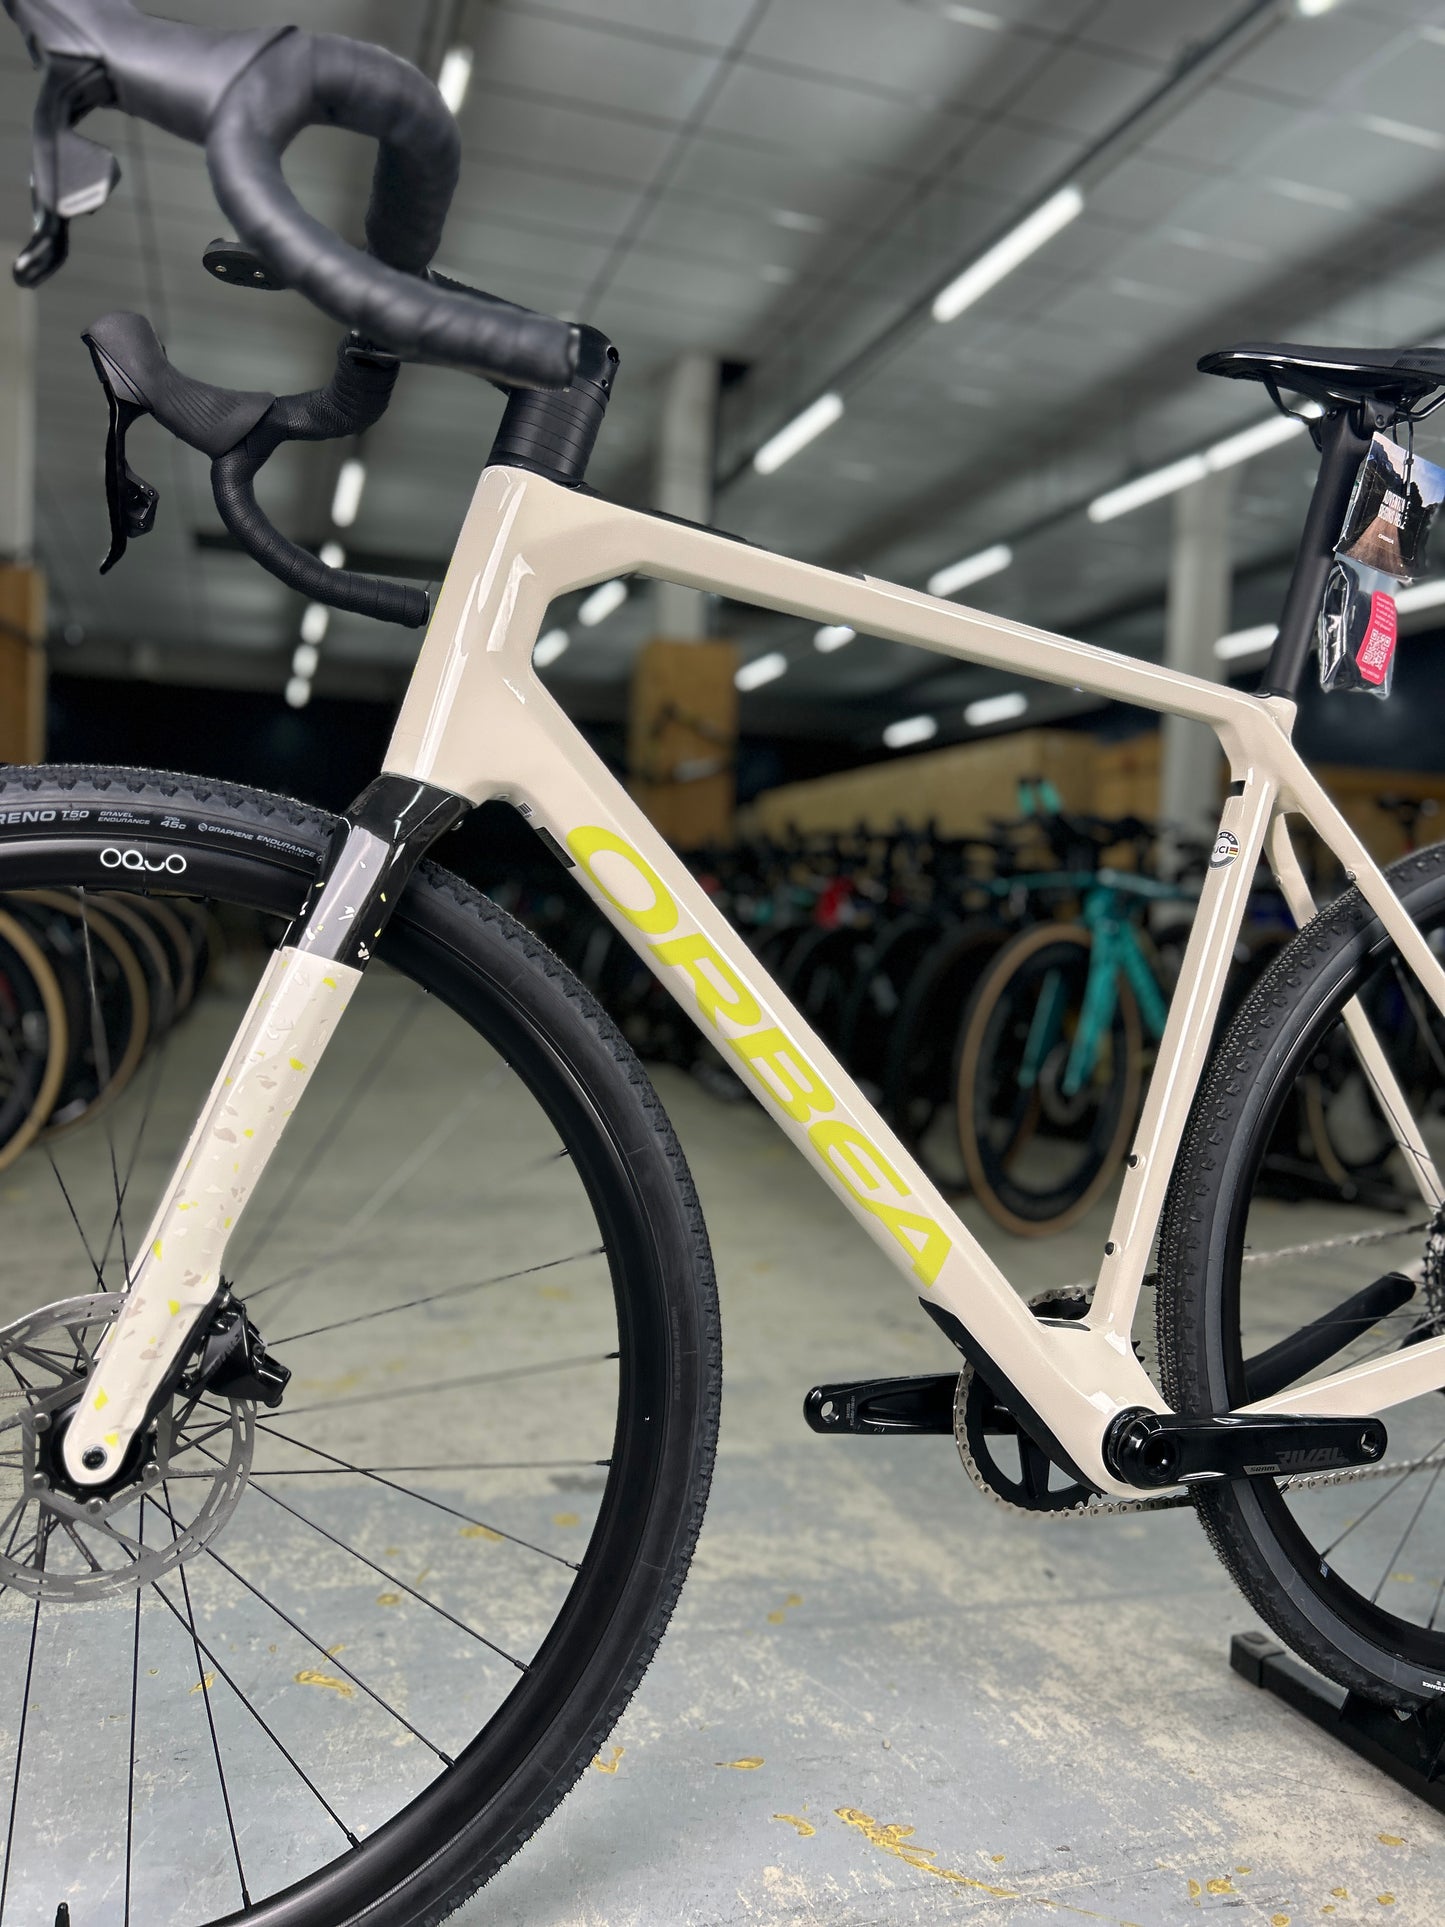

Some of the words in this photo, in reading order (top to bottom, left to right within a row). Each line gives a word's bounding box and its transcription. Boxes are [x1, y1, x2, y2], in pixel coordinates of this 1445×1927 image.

[97, 816, 150, 825] ENDURANCE
[208, 825, 254, 840] GRAPHENE
[256, 834, 317, 858] ENDURANCE
[100, 848, 187, 874] OQUO
[566, 825, 953, 1289] ORBEA
[1275, 1447, 1350, 1465] RIVAL
